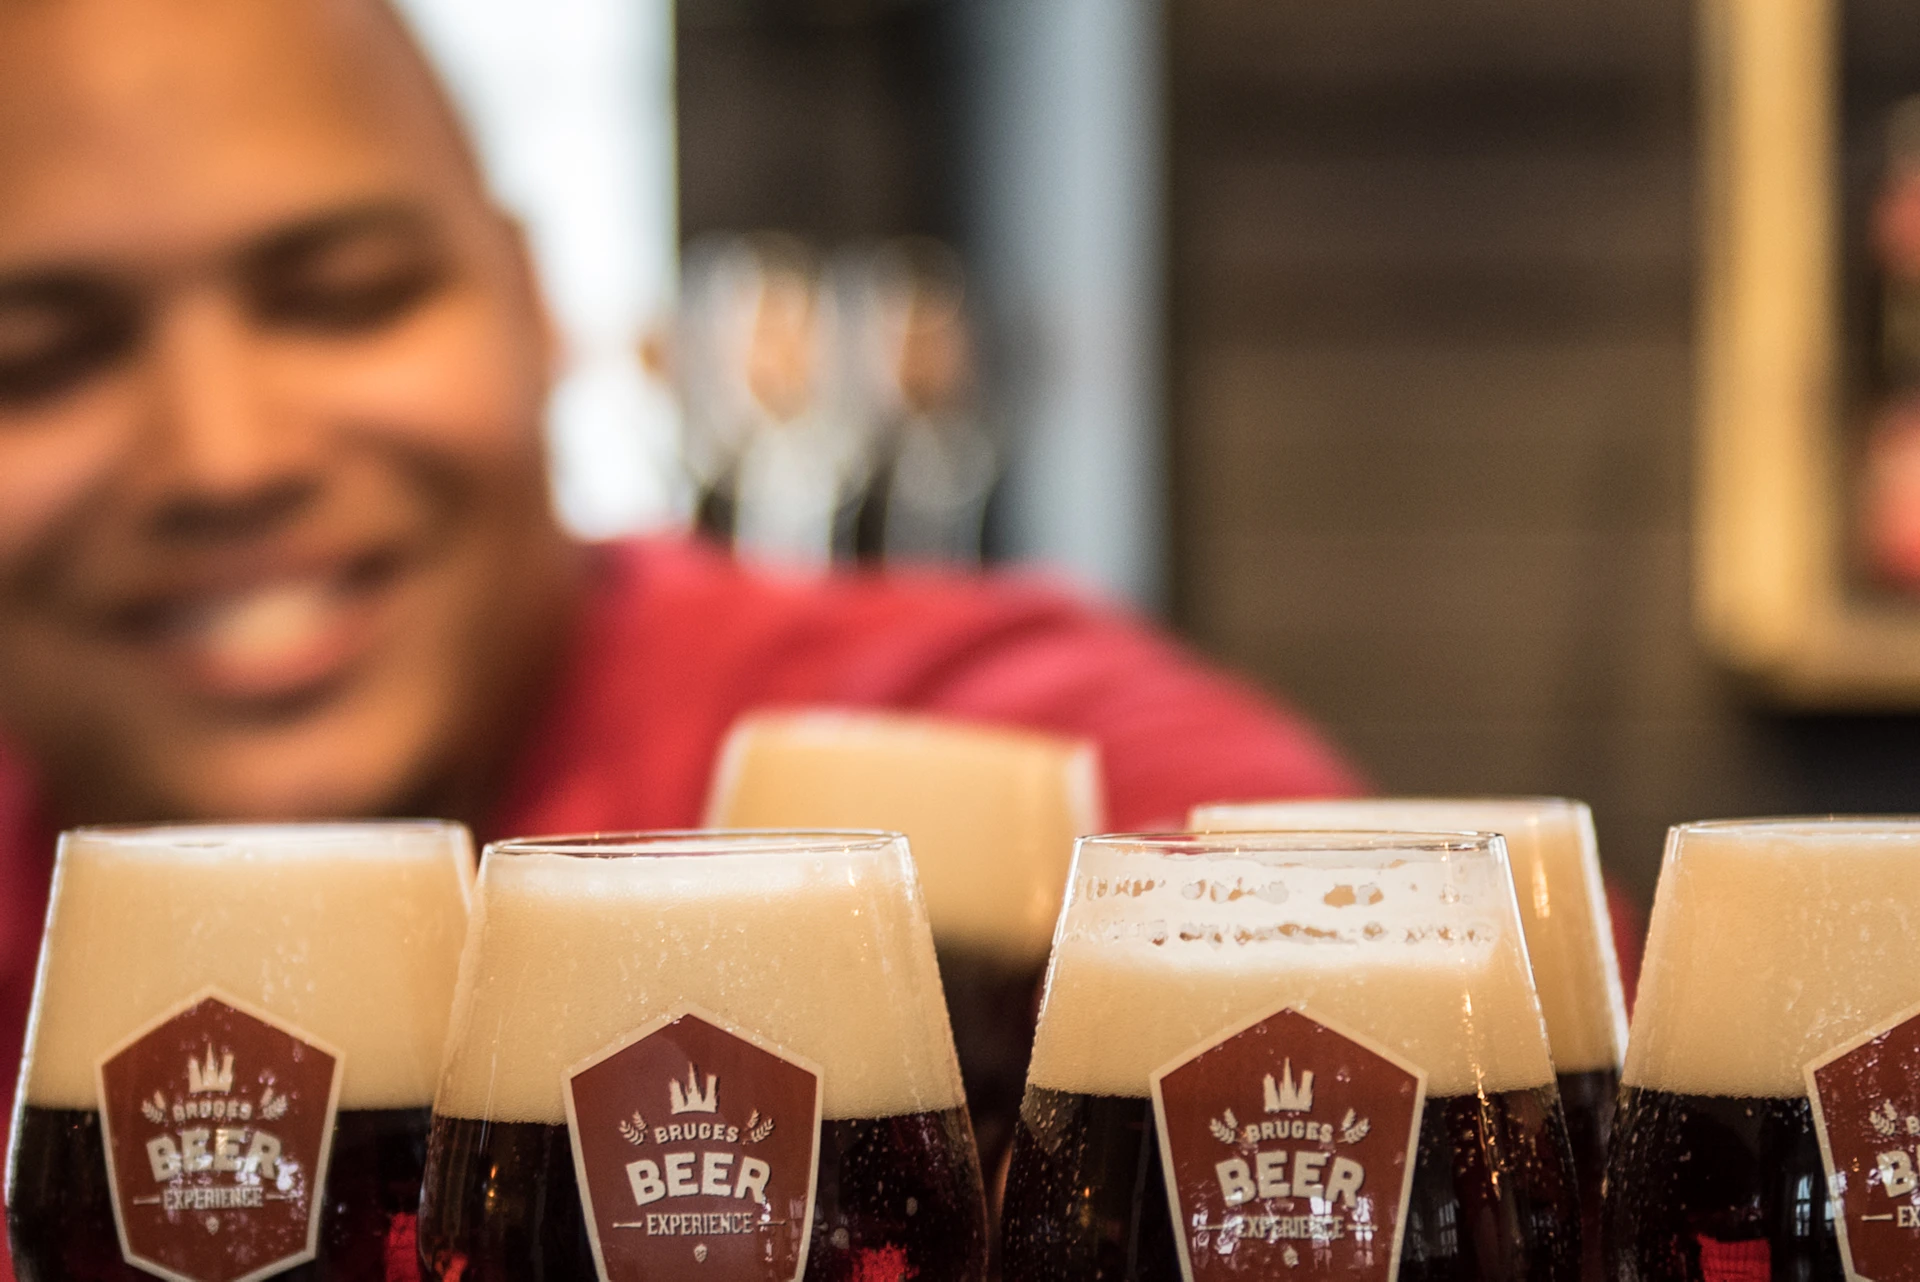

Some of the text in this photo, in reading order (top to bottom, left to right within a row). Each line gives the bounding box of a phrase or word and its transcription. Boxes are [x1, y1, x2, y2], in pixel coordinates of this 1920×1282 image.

[654, 1122, 740, 1144] BRUGES
[1246, 1121, 1333, 1143] BRUGES
[146, 1128, 282, 1182] BEER
[625, 1151, 771, 1206] BEER
[1215, 1150, 1365, 1208] BEER
[163, 1187, 263, 1210] EXPERIENCE
[646, 1212, 754, 1236] EXPERIENCE
